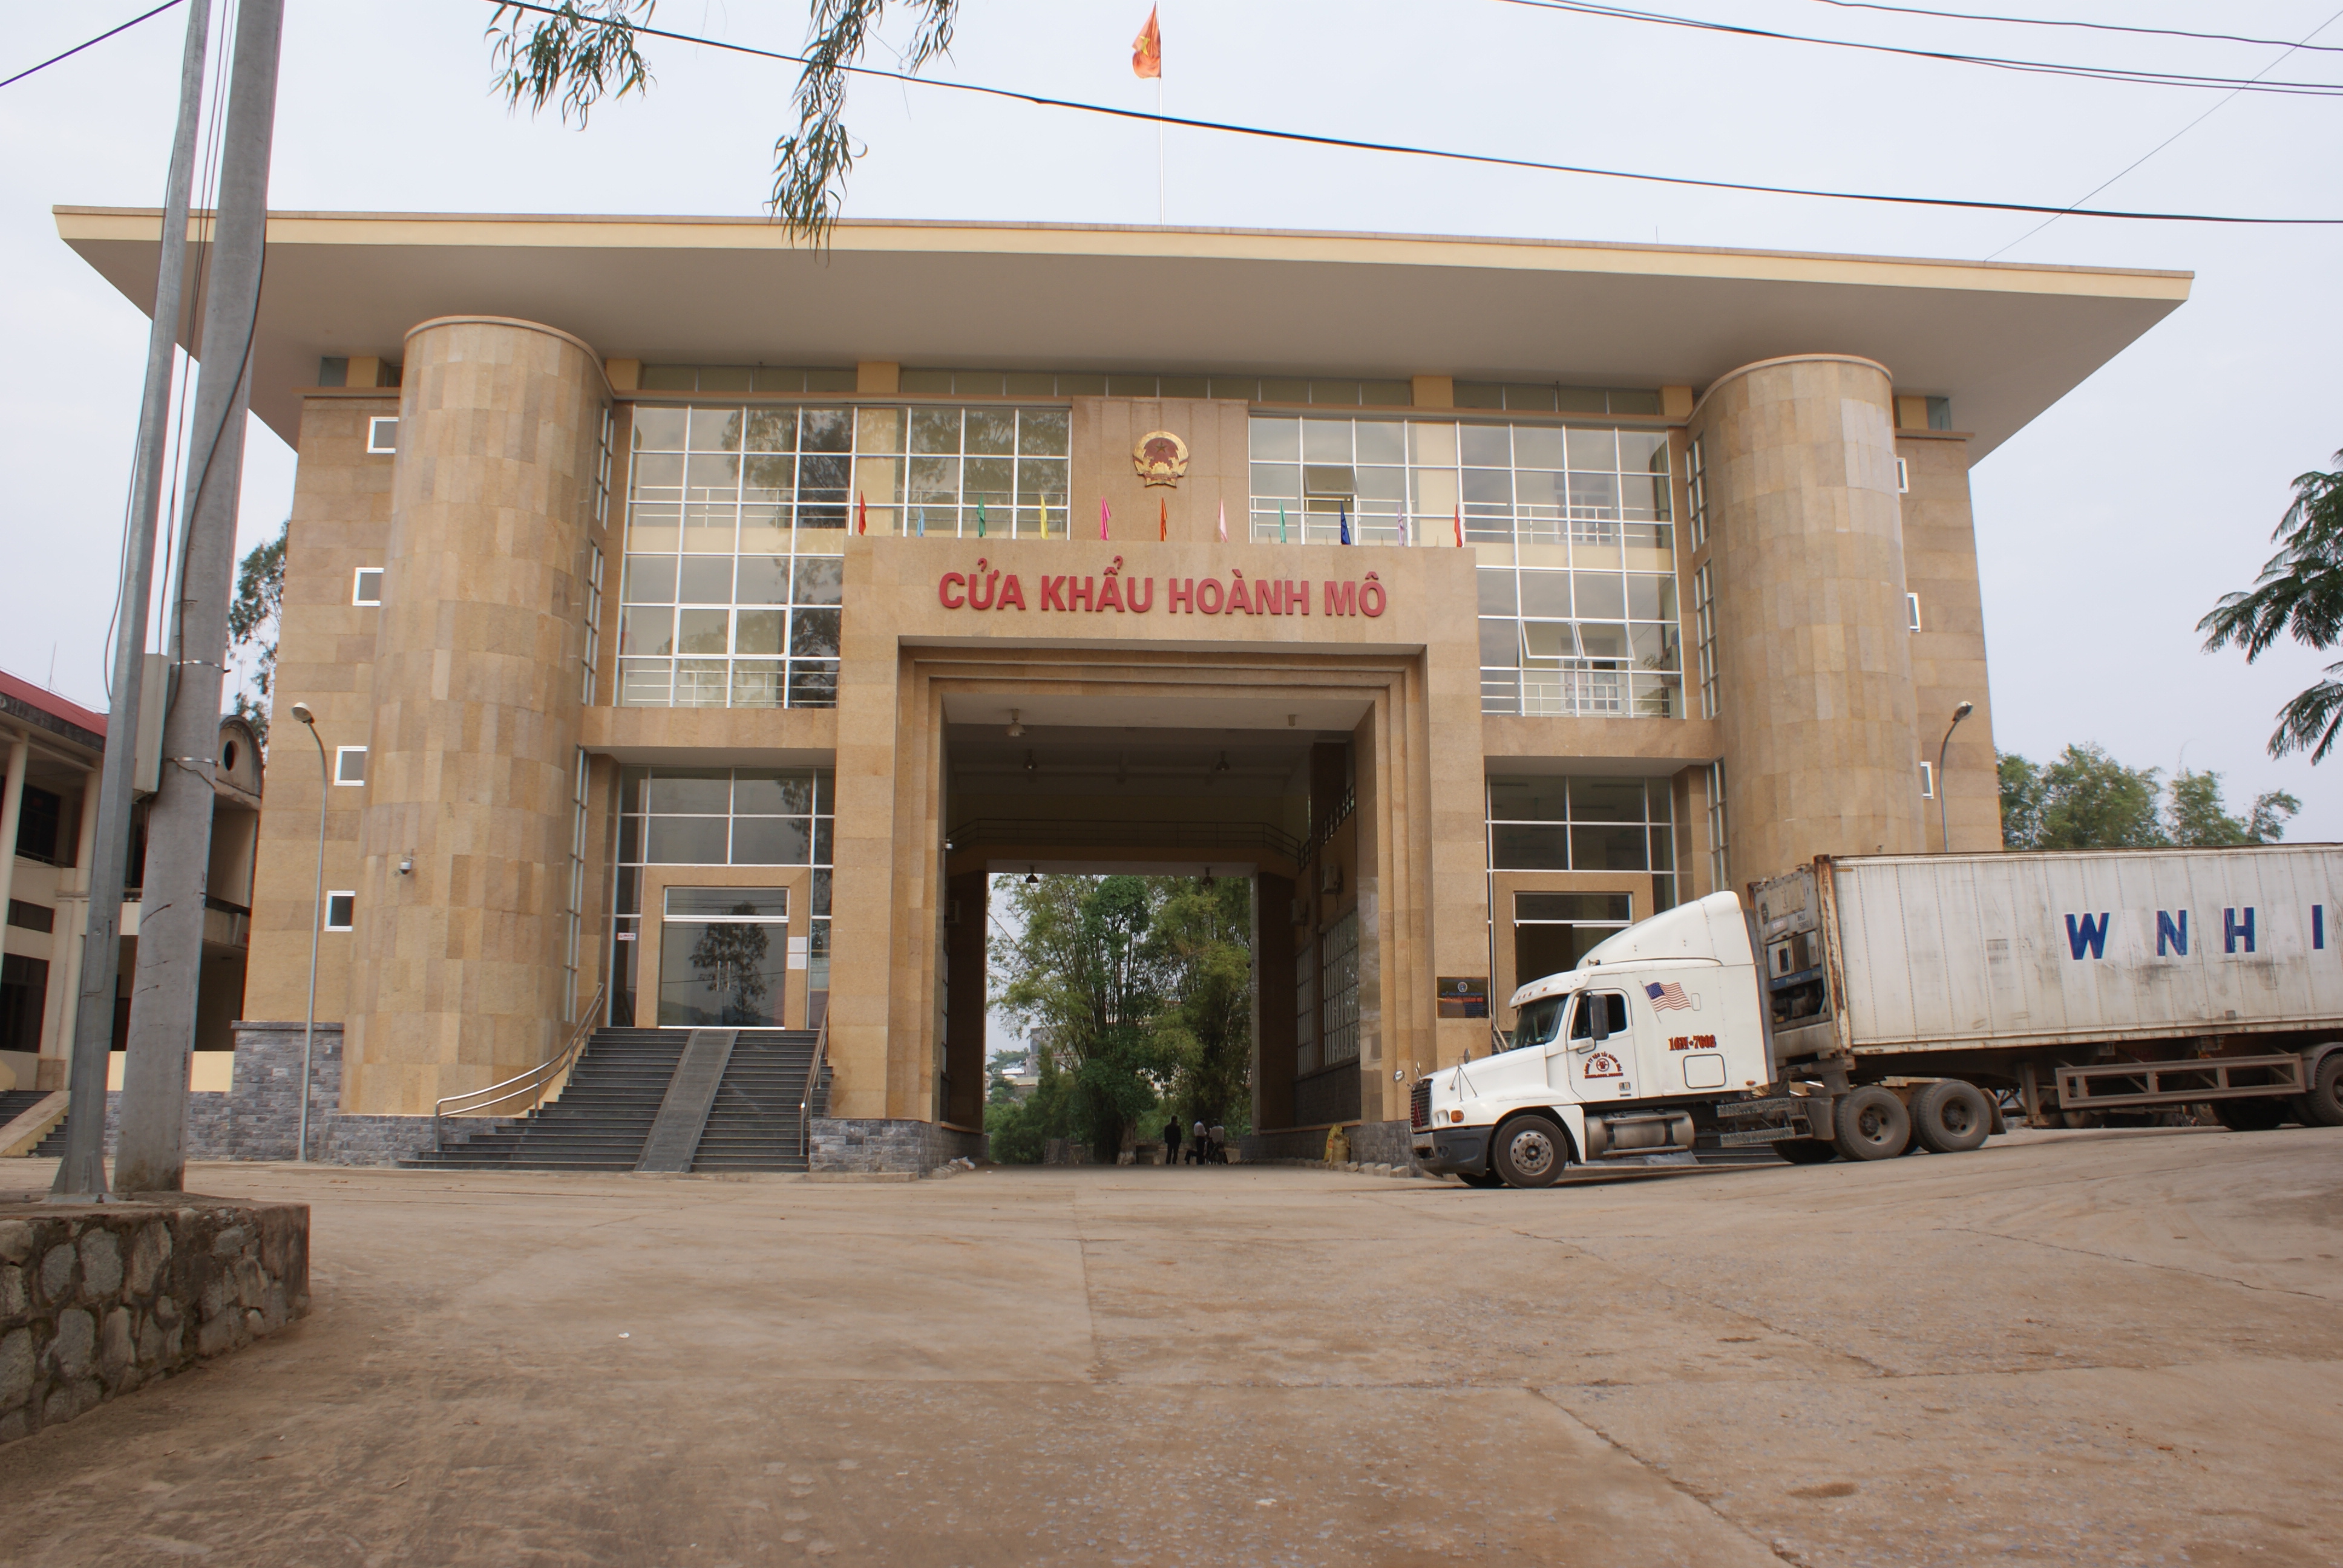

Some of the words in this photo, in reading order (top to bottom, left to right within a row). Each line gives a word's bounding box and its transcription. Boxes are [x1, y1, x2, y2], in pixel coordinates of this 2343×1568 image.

[939, 557, 1026, 610] CỬA
[1040, 555, 1153, 613] KHẨU
[1168, 569, 1309, 615] HOÀNH
[1324, 571, 1386, 617] MÔ
